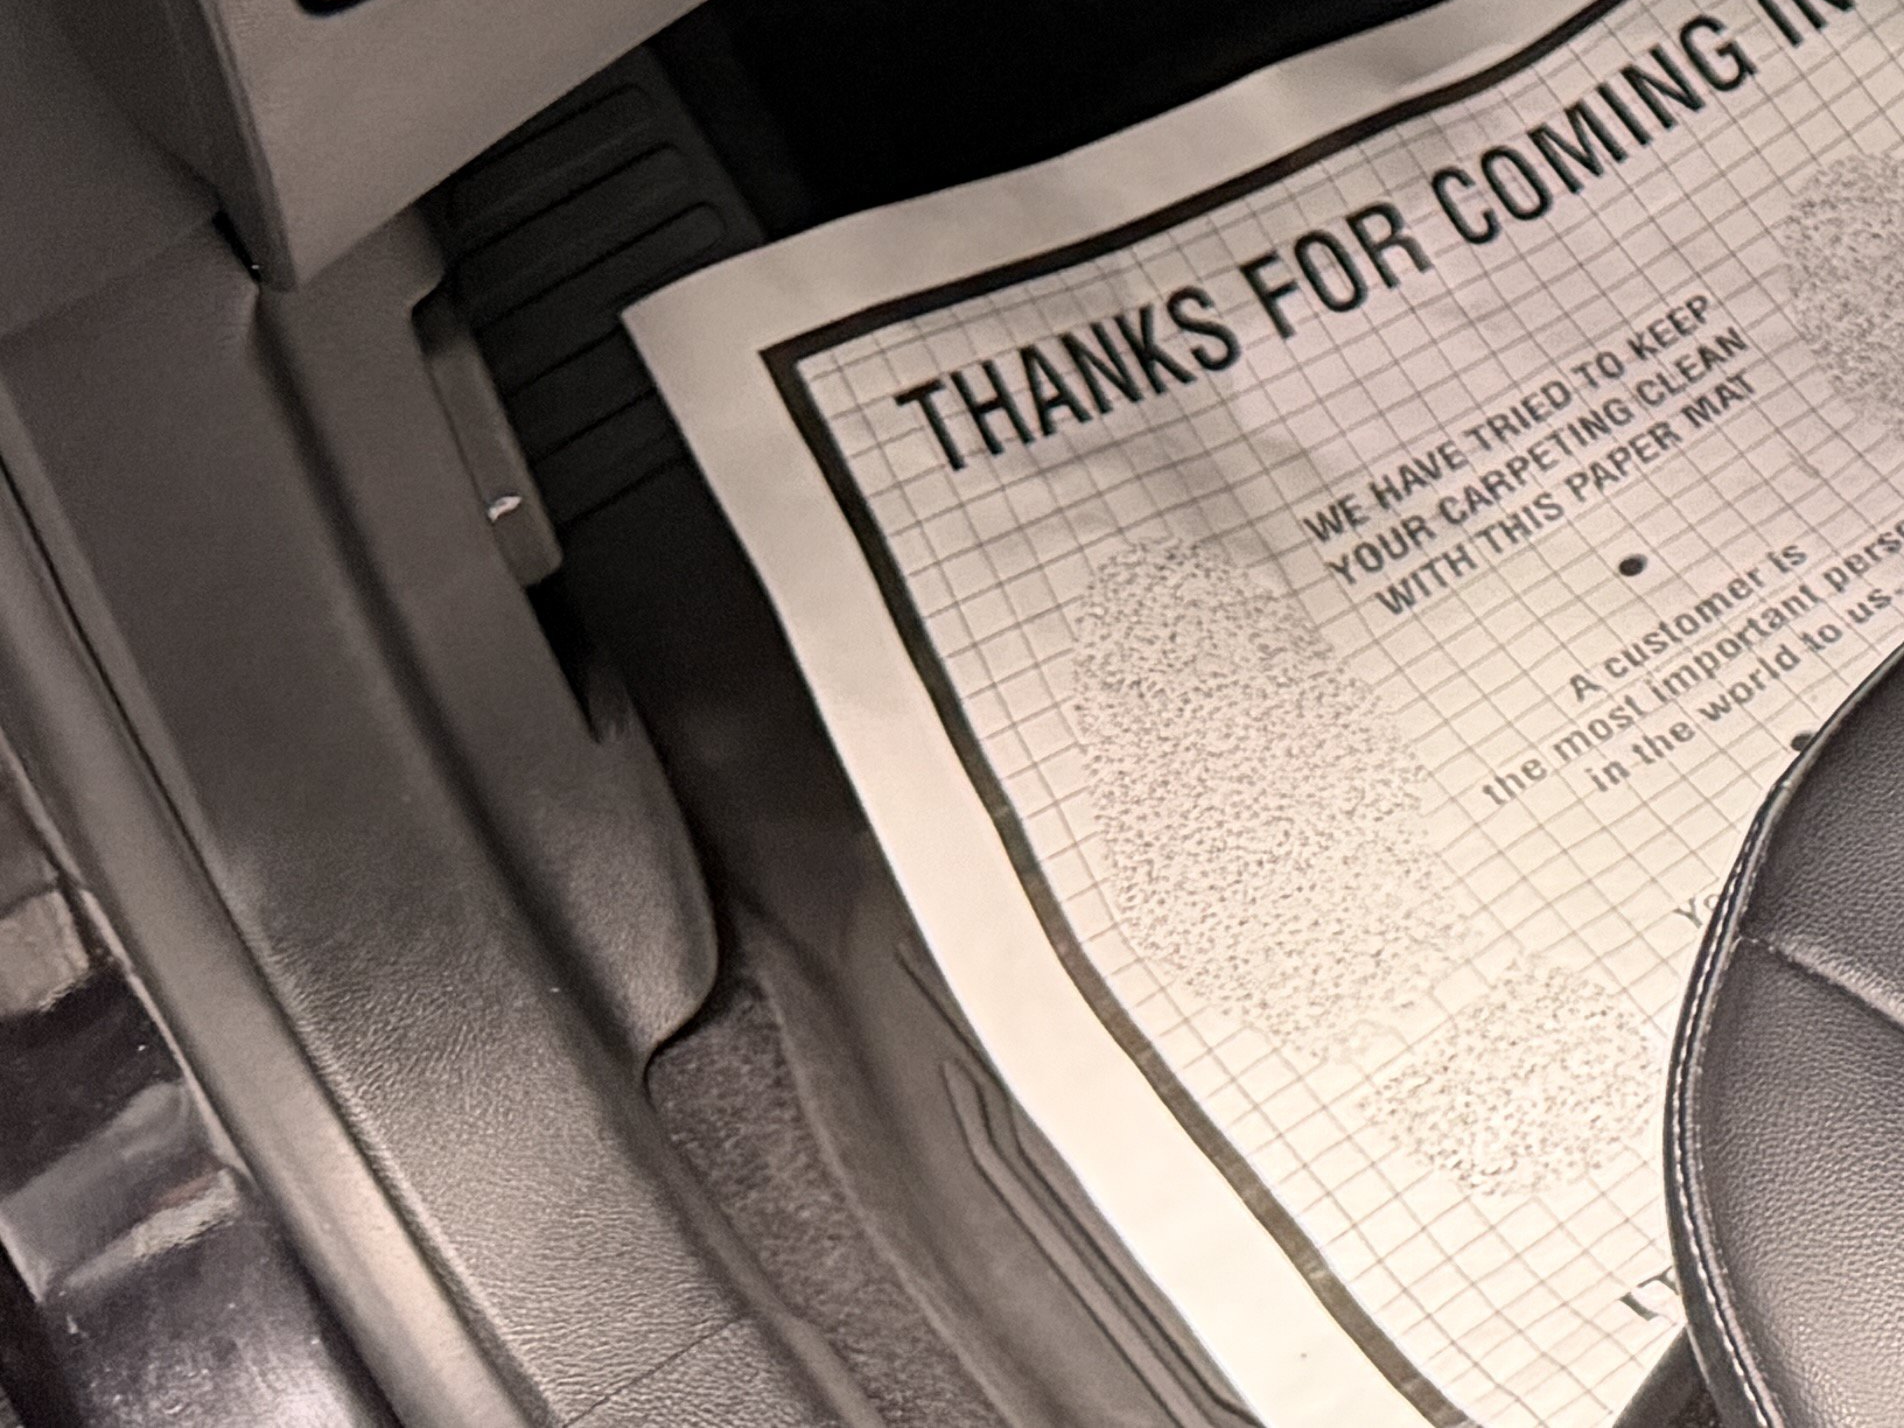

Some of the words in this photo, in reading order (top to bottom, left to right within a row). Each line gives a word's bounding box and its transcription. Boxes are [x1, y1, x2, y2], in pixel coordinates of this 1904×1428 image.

[894, 286, 1242, 472] THANKS
[1238, 201, 1434, 341] FOR
[1430, 15, 1759, 246] COMING
[1303, 493, 1370, 545] WE
[1369, 440, 1470, 511] HAVE
[1463, 380, 1573, 451] TRIED
[1571, 350, 1626, 390] TO
[1627, 294, 1711, 361] KEEP
[1325, 513, 1437, 588] YOUR
[1437, 397, 1635, 526] CARPETING
[1635, 326, 1750, 408] CLEAN
[1375, 543, 1479, 616] WITH
[1475, 492, 1565, 554] THIS
[1564, 420, 1683, 503] PAPER
[1681, 371, 1757, 429] MAT
[1481, 757, 1548, 806] the
[1553, 692, 1645, 764] most
[1645, 584, 1820, 706] important
[1568, 673, 1599, 703] A
[1603, 565, 1774, 680] customer
[1766, 543, 1808, 574] is
[1585, 758, 1631, 794] in
[1632, 721, 1696, 767] the
[1696, 644, 1800, 723] world
[1799, 623, 1843, 655] to
[1846, 585, 1904, 626] us.
